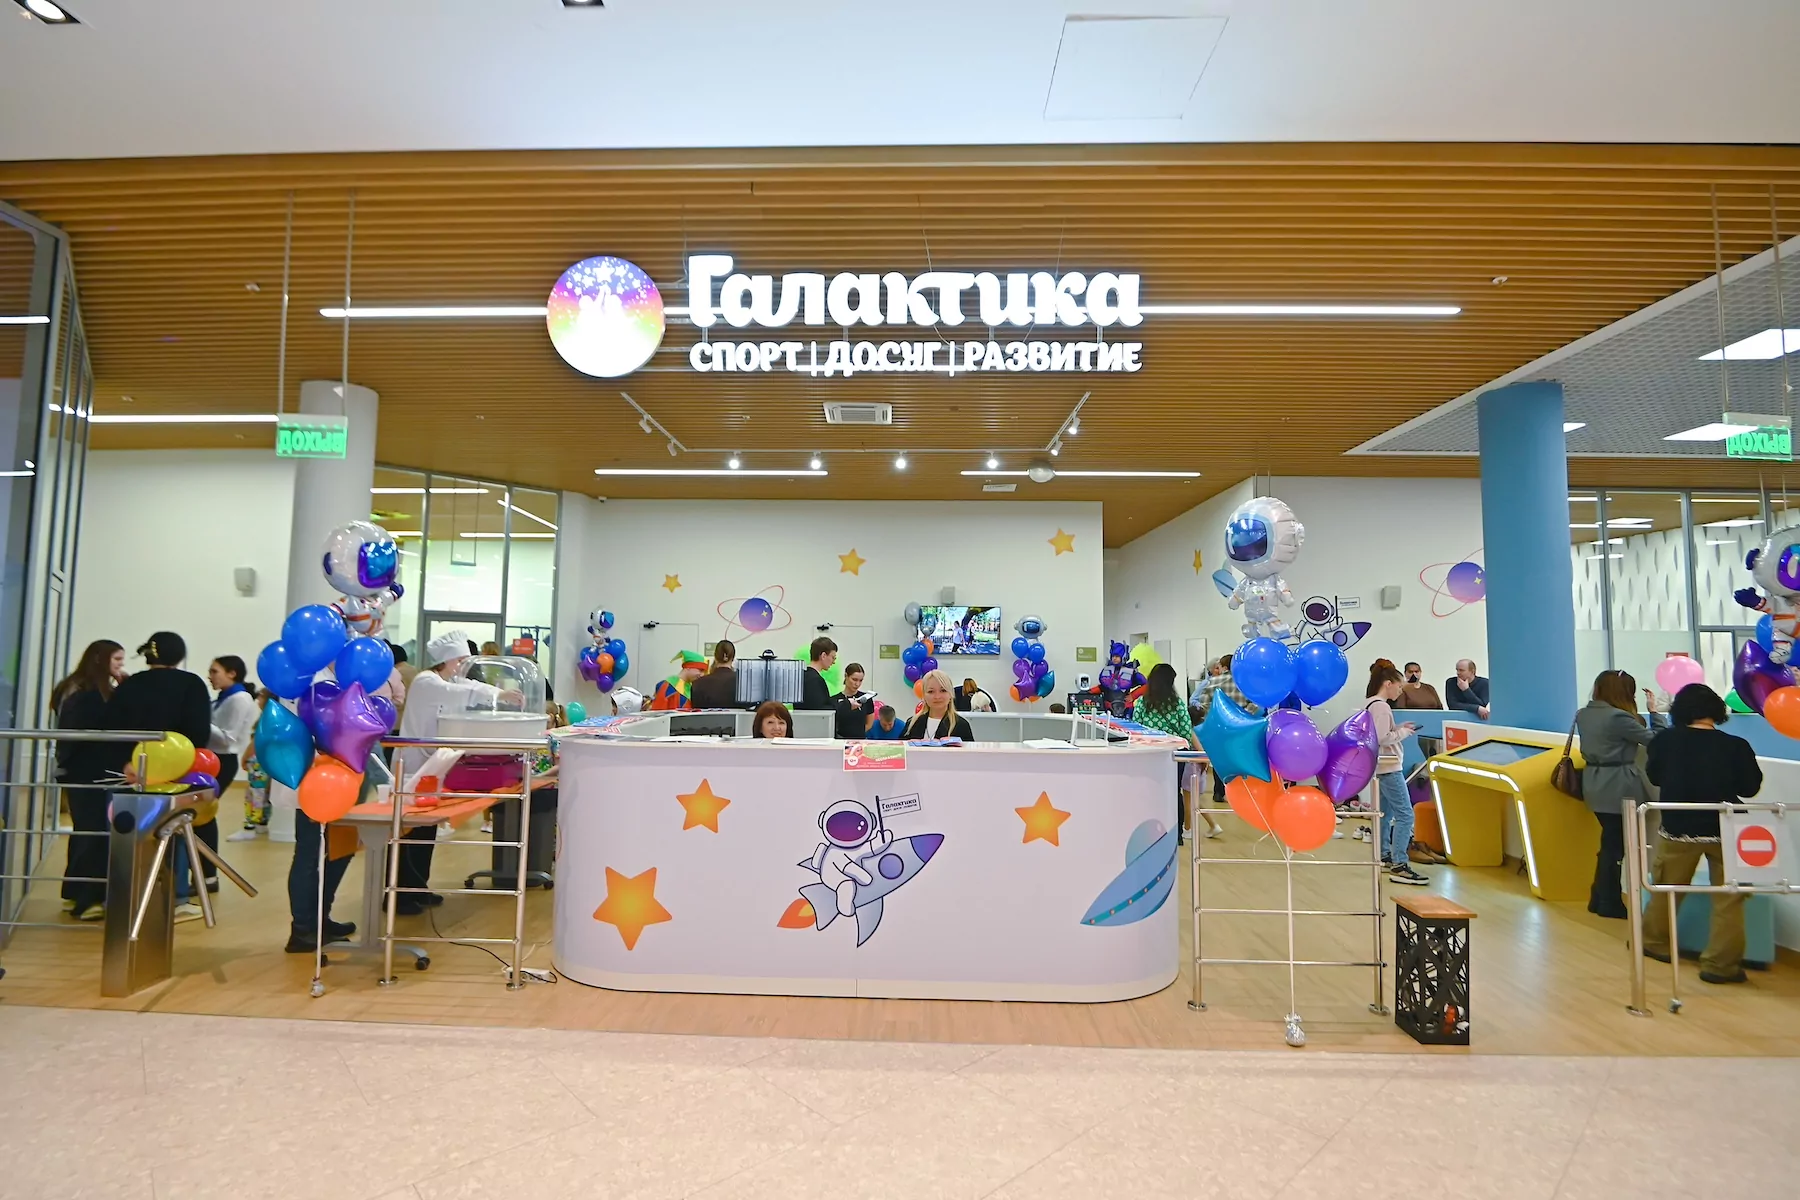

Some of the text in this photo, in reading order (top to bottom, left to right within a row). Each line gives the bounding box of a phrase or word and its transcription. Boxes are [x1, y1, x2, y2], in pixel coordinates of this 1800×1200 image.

[688, 254, 1143, 327] Галактика
[689, 341, 1143, 377] СПОРТ ДОСУГ РАЗВИТИЕ
[881, 799, 917, 810] Галактика
